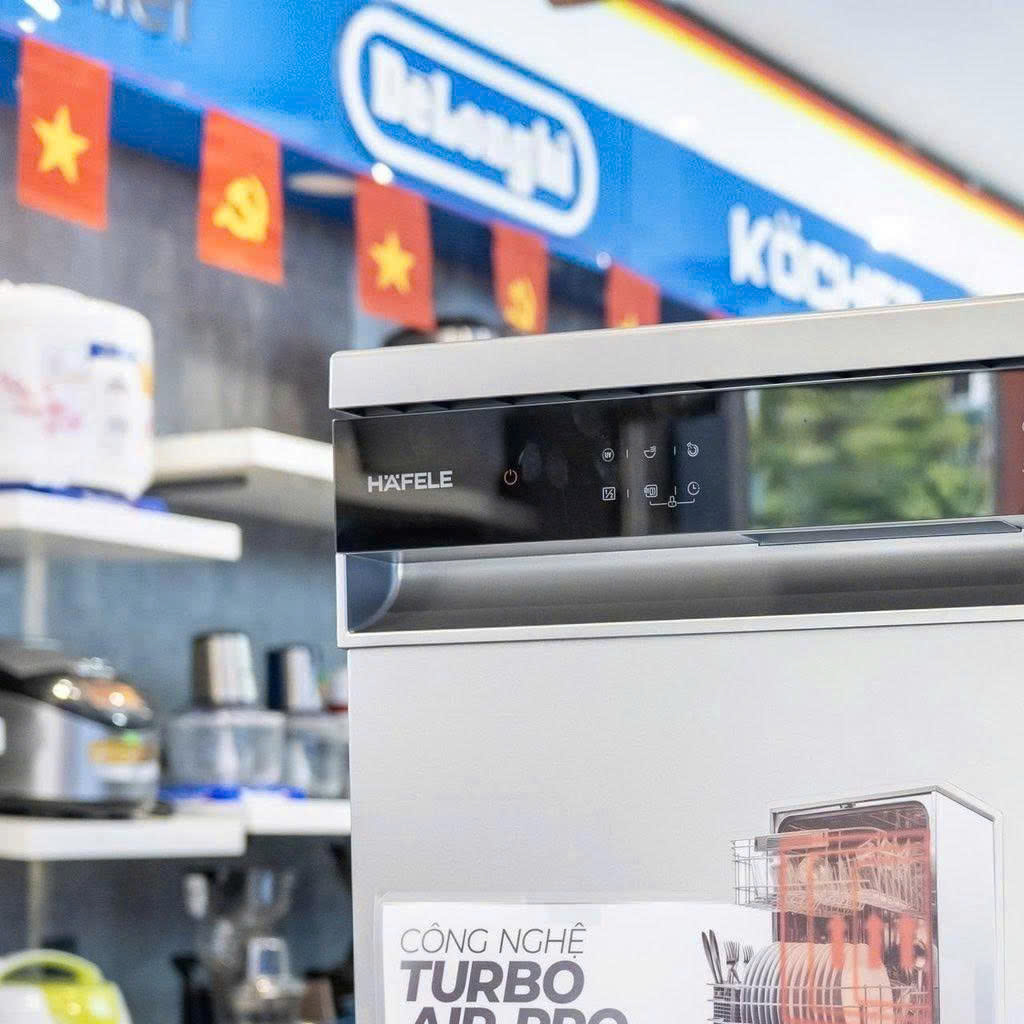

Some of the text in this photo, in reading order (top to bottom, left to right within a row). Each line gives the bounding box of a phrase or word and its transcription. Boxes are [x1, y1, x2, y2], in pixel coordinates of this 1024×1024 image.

[729, 202, 924, 311] KÖCH
[367, 470, 453, 493] HÄFELE
[400, 922, 586, 959] CÔNG NGHỆ
[400, 960, 585, 1004] TURBO
